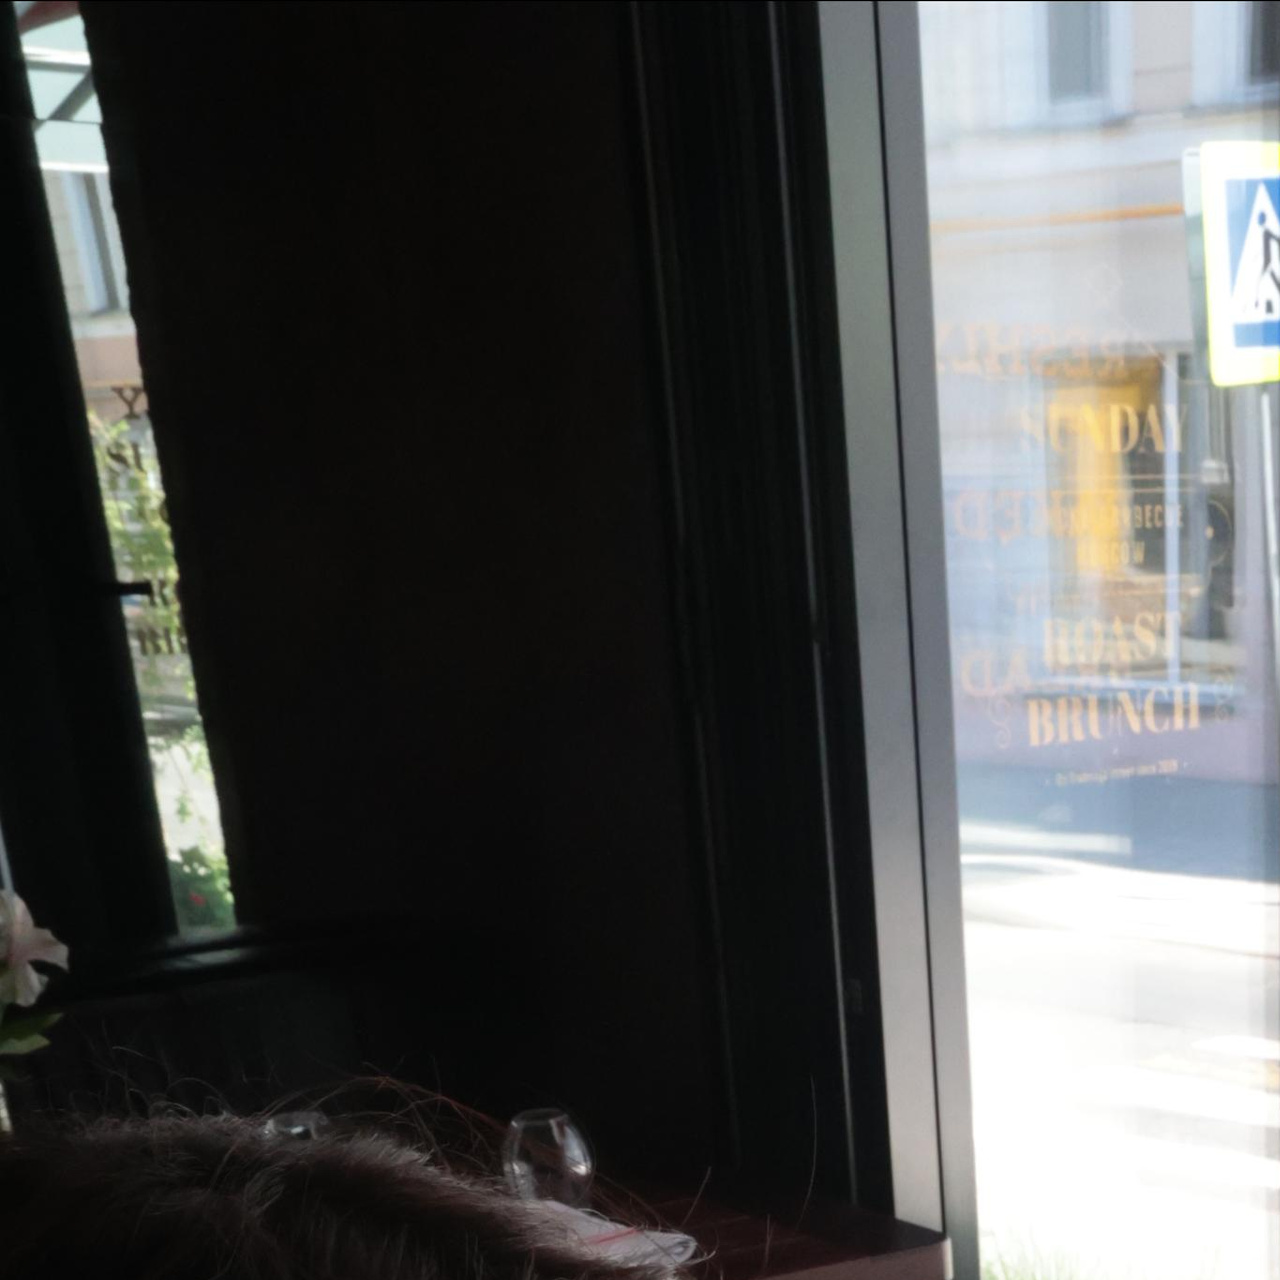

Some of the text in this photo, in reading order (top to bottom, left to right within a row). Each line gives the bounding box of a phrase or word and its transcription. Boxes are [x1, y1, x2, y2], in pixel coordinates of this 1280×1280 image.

[1018, 403, 1188, 454] SUNDAY
[1043, 611, 1182, 668] ROAST
[1027, 682, 1201, 746] BRUNCH
